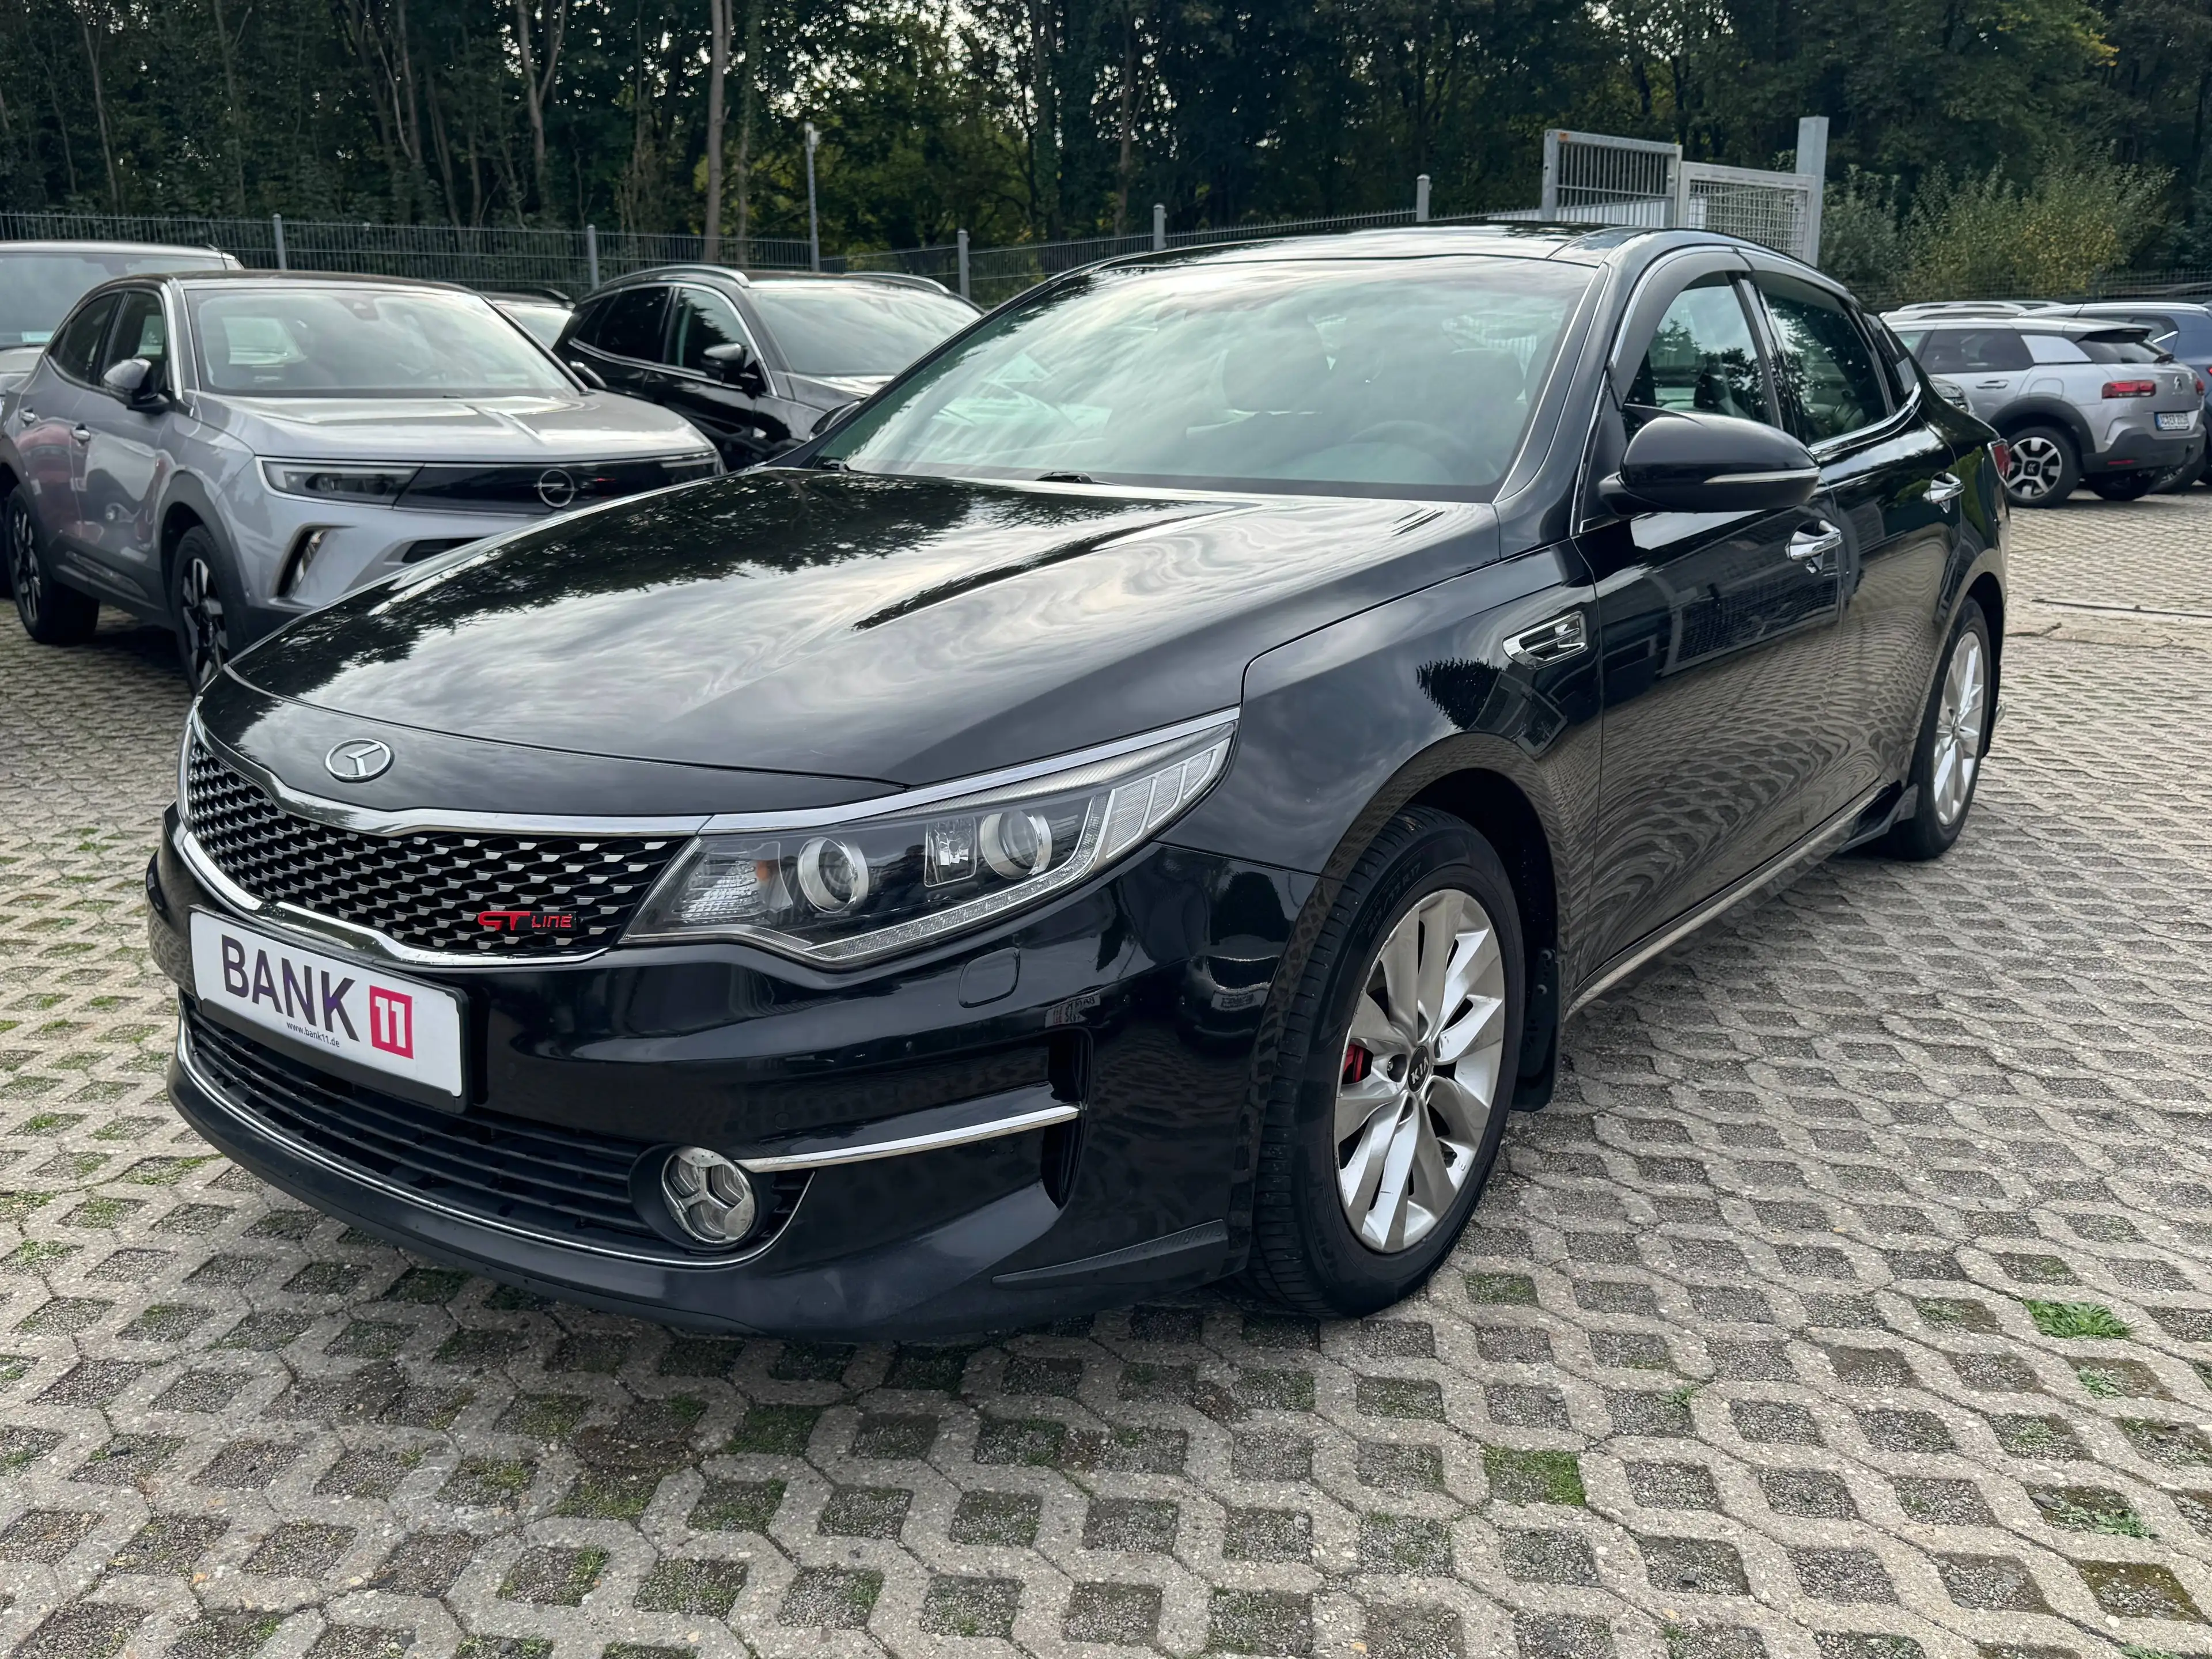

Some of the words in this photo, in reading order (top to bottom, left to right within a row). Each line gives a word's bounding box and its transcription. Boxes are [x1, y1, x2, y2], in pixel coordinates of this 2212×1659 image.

[478, 910, 531, 931] GT
[221, 934, 361, 1042] BANK
[374, 995, 407, 1050] 11
[286, 1021, 340, 1048] www.bank11.de
[1411, 1056, 1429, 1085] KIA
